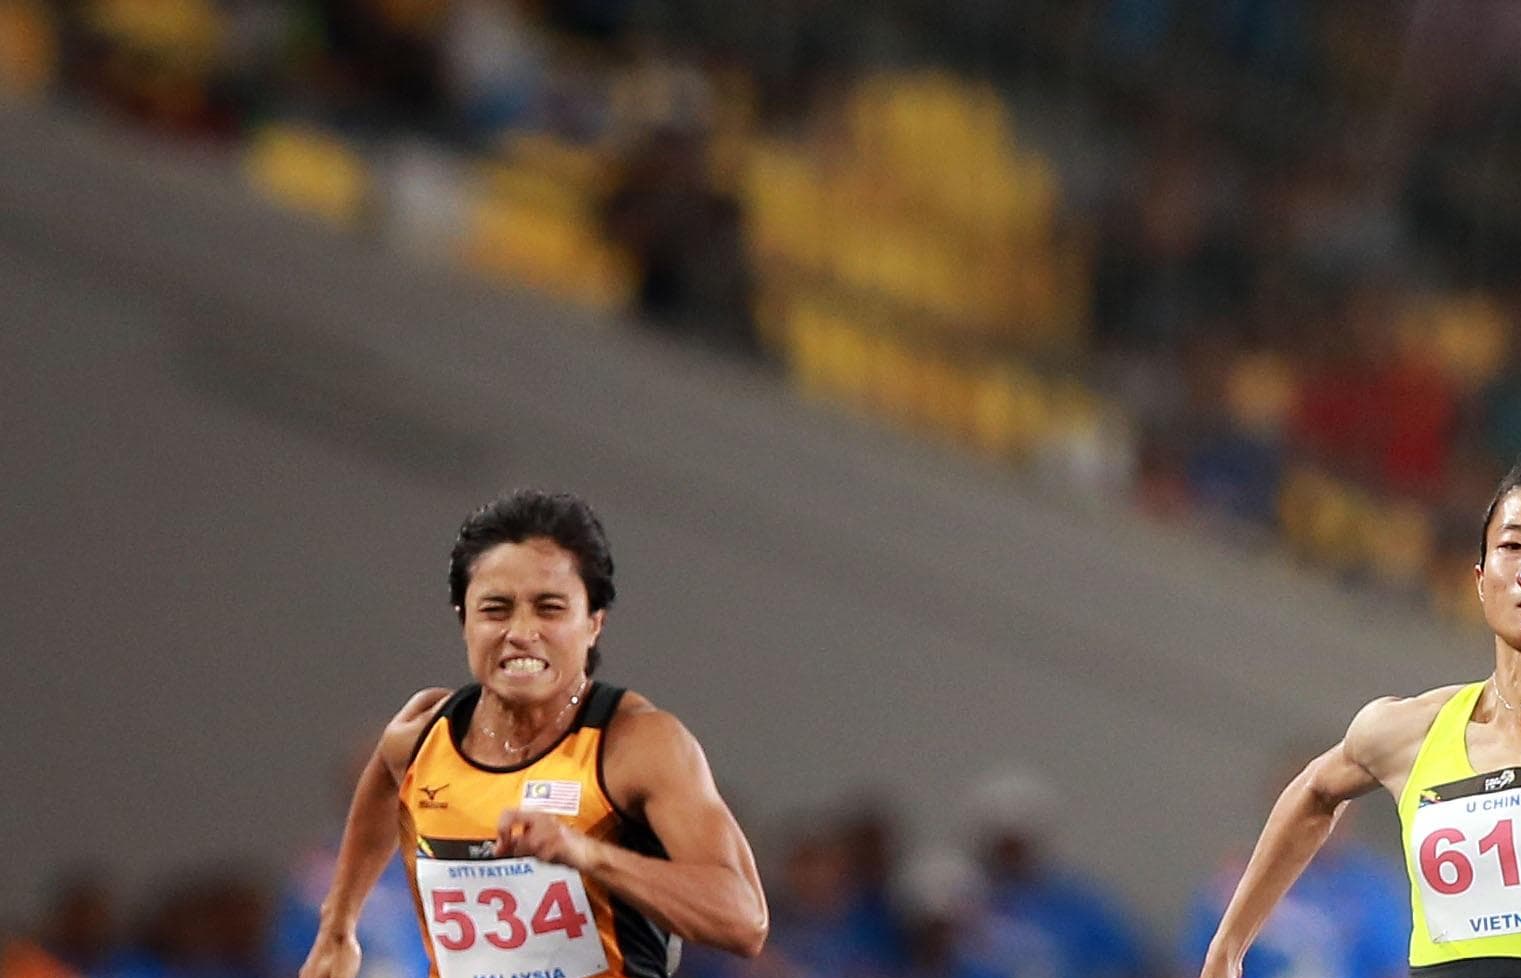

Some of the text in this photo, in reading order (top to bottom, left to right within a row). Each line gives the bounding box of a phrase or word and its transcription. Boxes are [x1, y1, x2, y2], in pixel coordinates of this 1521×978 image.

[1466, 801, 1476, 813] U
[478, 863, 534, 877] FATIMA
[431, 880, 588, 951] 534
